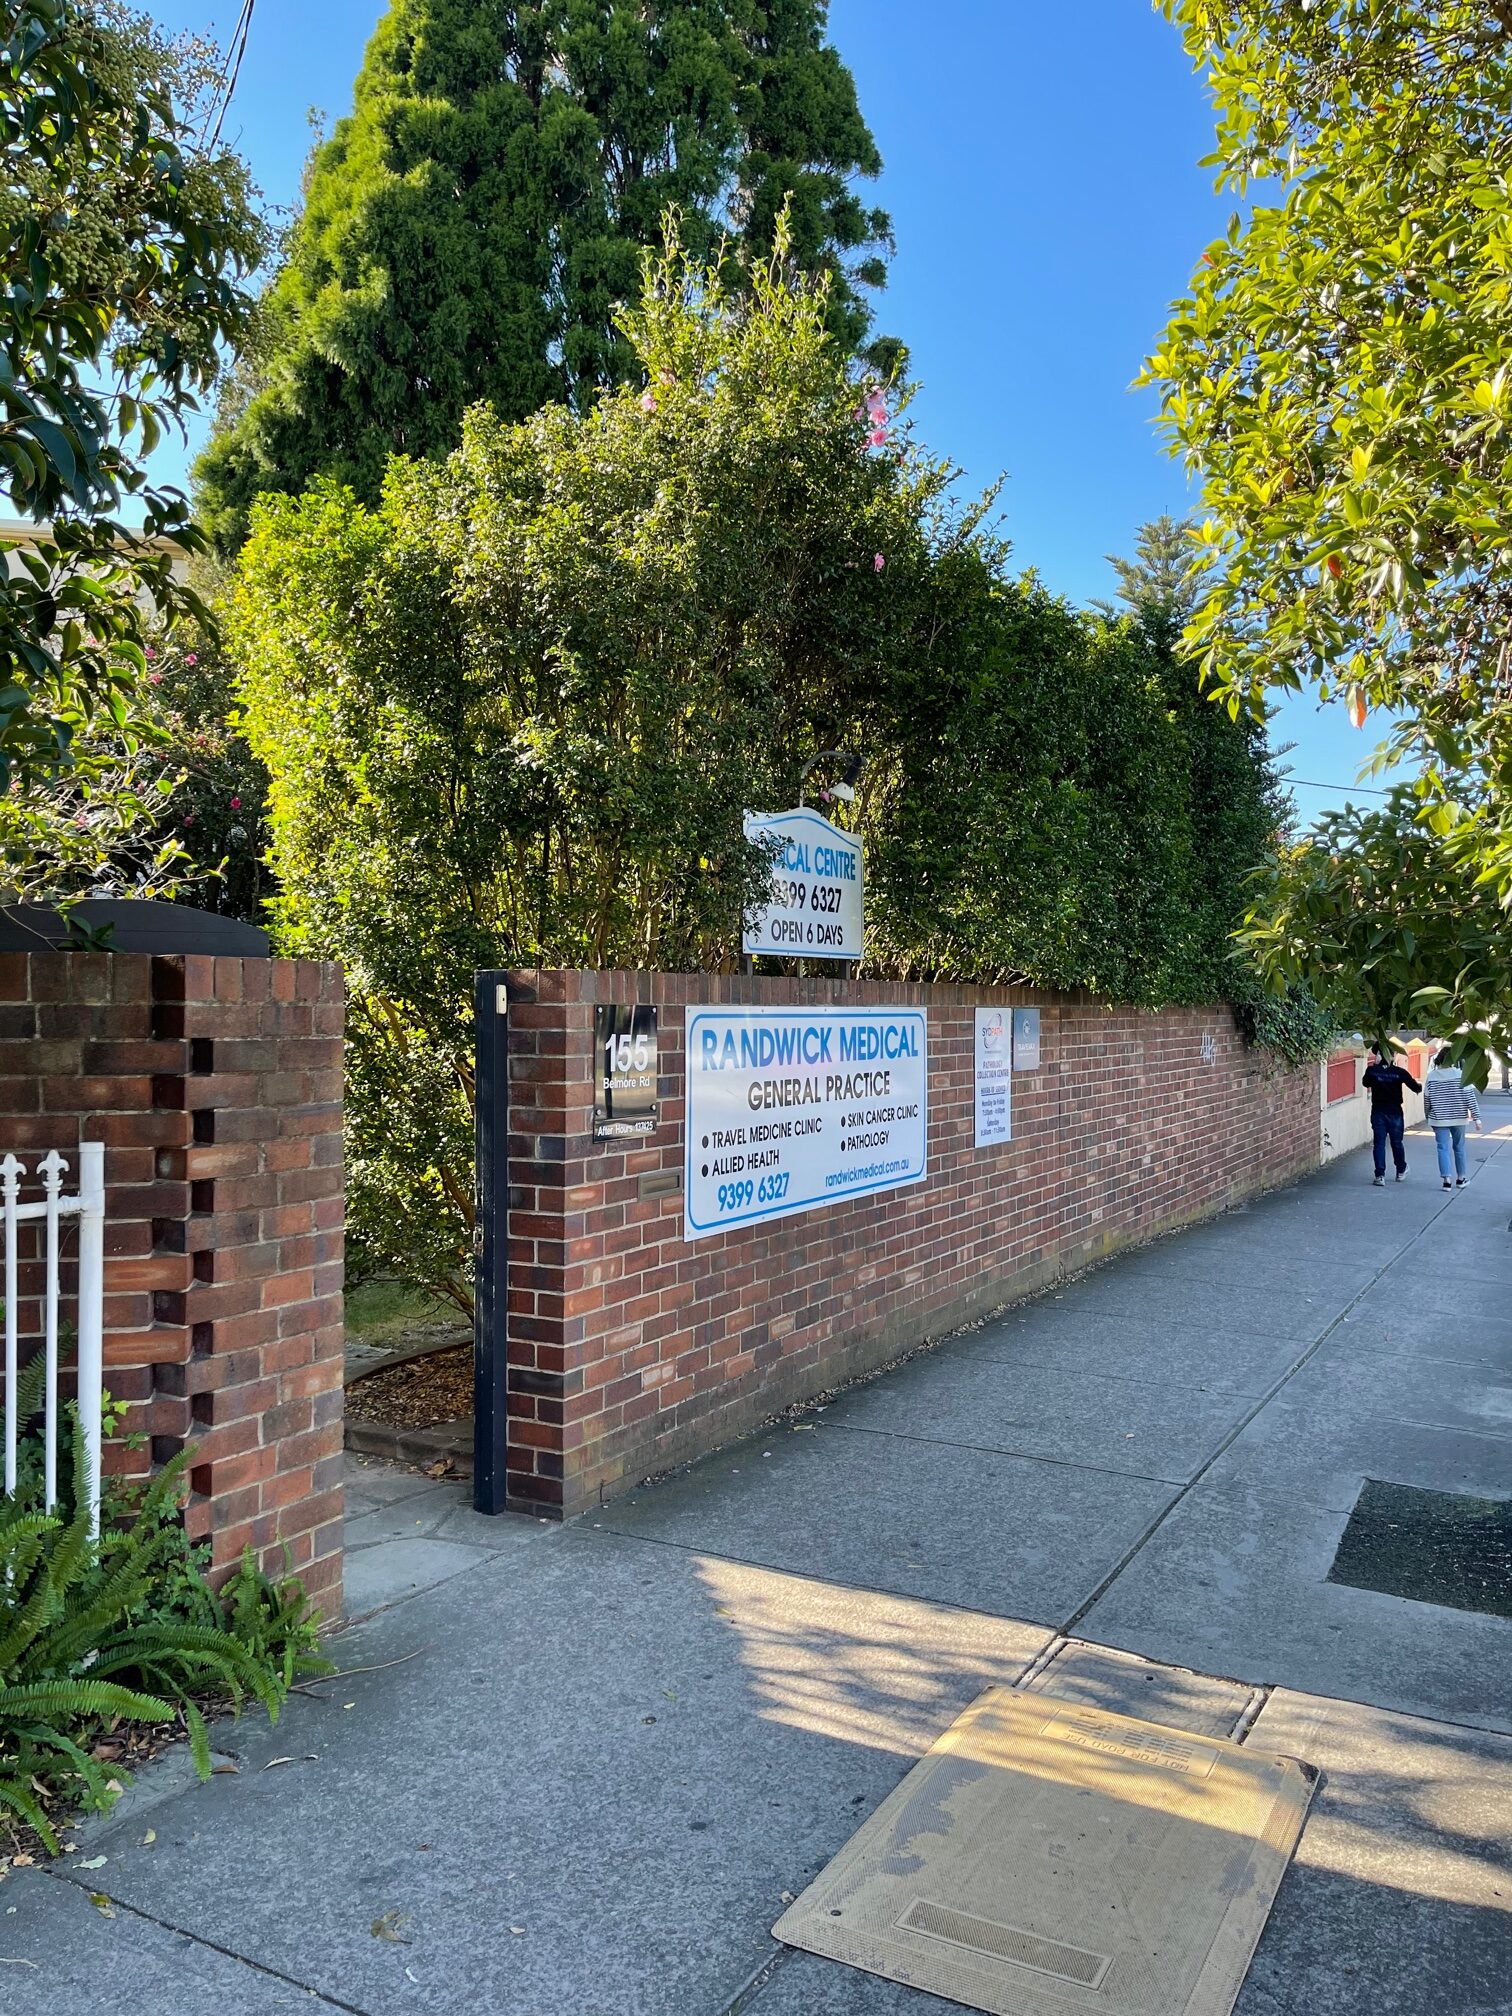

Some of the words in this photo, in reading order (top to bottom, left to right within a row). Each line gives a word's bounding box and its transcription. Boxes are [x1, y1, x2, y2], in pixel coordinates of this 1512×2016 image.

[814, 846, 856, 881] CENTRE
[811, 885, 842, 913] 6327
[771, 919, 803, 943] OPEN
[806, 923, 814, 944] 6
[817, 924, 843, 946] DAYS
[605, 1033, 649, 1072] 155
[702, 1026, 832, 1071] RANDWICK
[839, 1025, 918, 1062] MEDICAL
[603, 1076, 636, 1090] Belmore
[639, 1075, 650, 1087] Rd
[748, 1077, 821, 1111] GENERAL
[826, 1071, 890, 1102] PRACTICE
[847, 1111, 864, 1128] SKIN
[866, 1107, 895, 1125] CANCER
[896, 1104, 918, 1120] CLINIC
[597, 1125, 613, 1137] After
[615, 1124, 633, 1135] Hours
[712, 1127, 747, 1149] TRAVEL
[749, 1121, 792, 1143] MEDICINE
[794, 1117, 822, 1138] CLINIC
[847, 1130, 890, 1151] PATHOLOGY
[712, 1155, 744, 1177] ALLIED
[747, 1149, 780, 1171] HEALTH
[825, 1158, 910, 1188] randwickmedical.com.au
[717, 1180, 753, 1212] 9399
[758, 1172, 790, 1203] 6327
[1062, 1733, 1088, 1747] USE
[1092, 1740, 1126, 1755] ROAD
[1131, 1749, 1158, 1764] FOR
[1161, 1758, 1190, 1772] NOT
